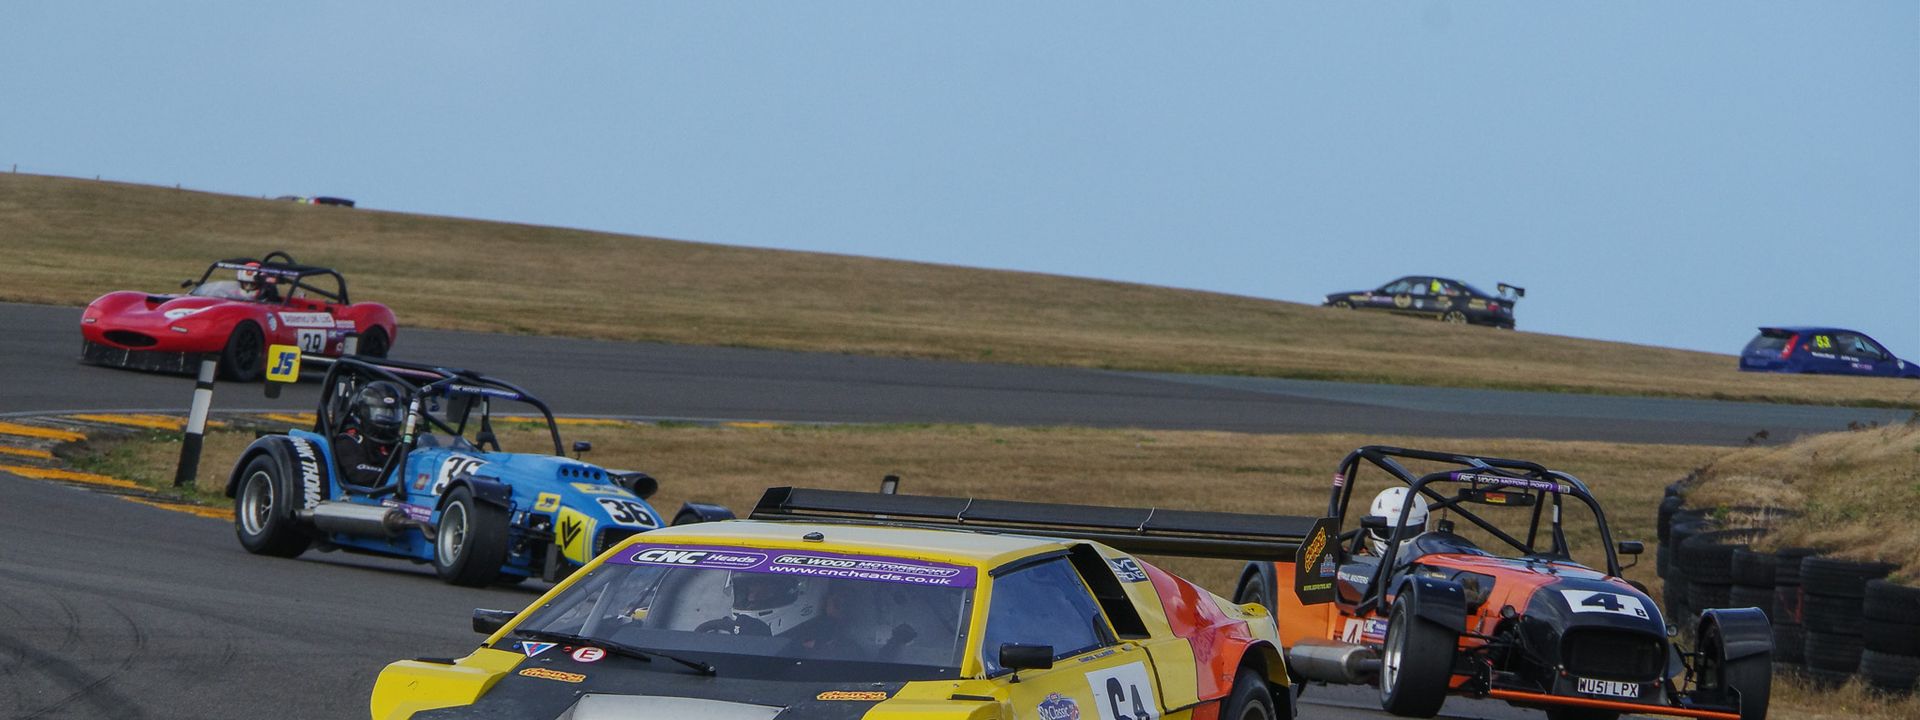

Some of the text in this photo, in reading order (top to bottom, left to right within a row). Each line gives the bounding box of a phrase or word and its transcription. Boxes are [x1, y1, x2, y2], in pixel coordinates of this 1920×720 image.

[1815, 335, 1832, 349] 53
[301, 458, 322, 509] THOMA
[599, 498, 656, 527] 36
[638, 550, 706, 564] CNC
[707, 554, 757, 563] Heads
[778, 556, 957, 576] RIC WOOD MOTORSPORT
[769, 566, 952, 585] www.cncheads.co.uk
[1581, 593, 1625, 611] 4
[580, 649, 598, 659] E
[1613, 682, 1638, 697] LPX
